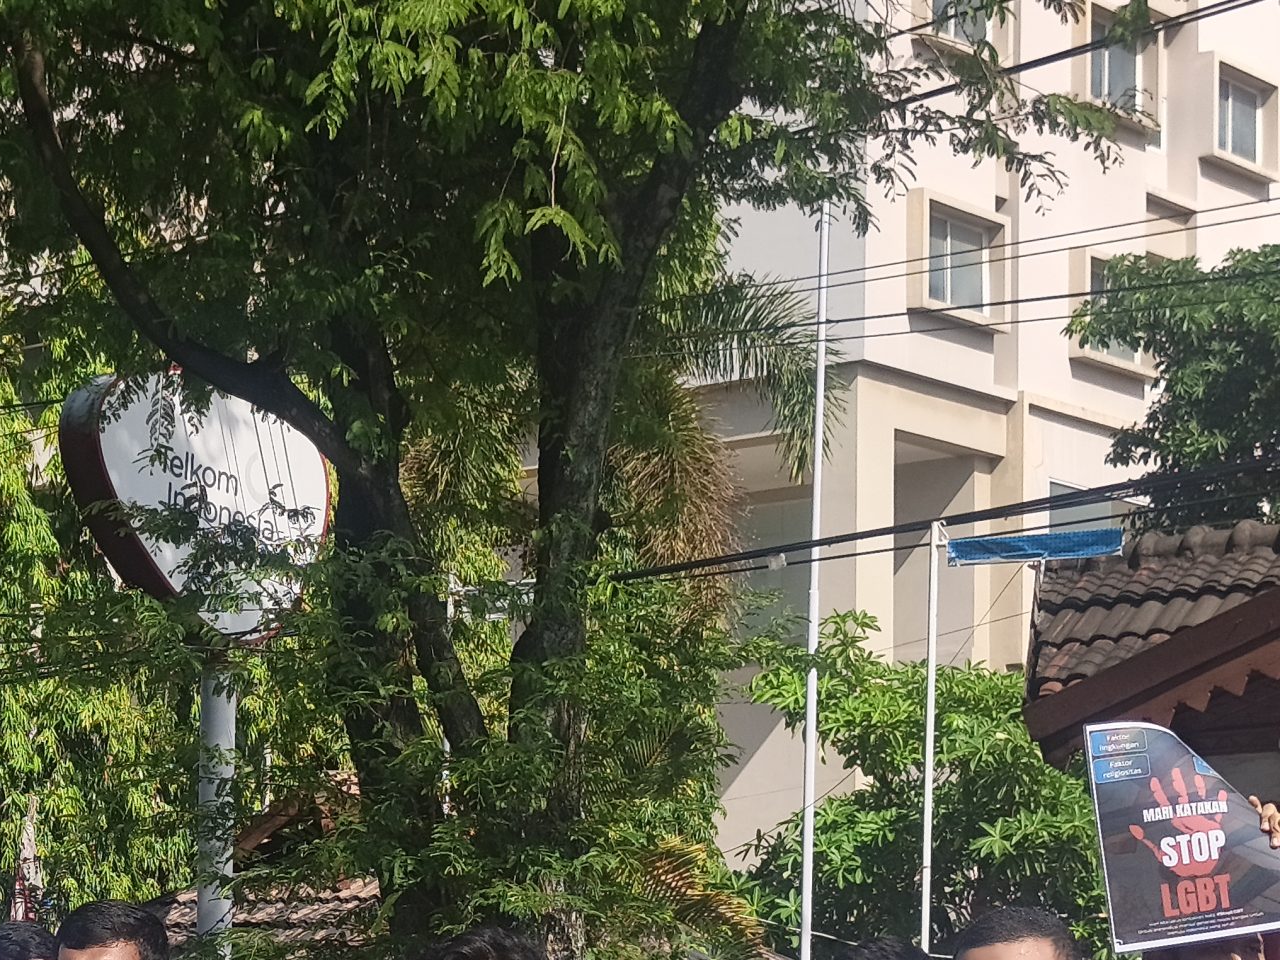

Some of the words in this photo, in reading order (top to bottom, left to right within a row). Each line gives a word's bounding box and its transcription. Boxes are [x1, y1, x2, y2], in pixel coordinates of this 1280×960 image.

[160, 444, 238, 496] Telkom
[168, 482, 275, 541] Inonesia
[1142, 806, 1174, 823] MARI
[1175, 801, 1228, 819] KATAKAN
[1160, 829, 1226, 868] STOP
[1160, 873, 1231, 918] LGBT
